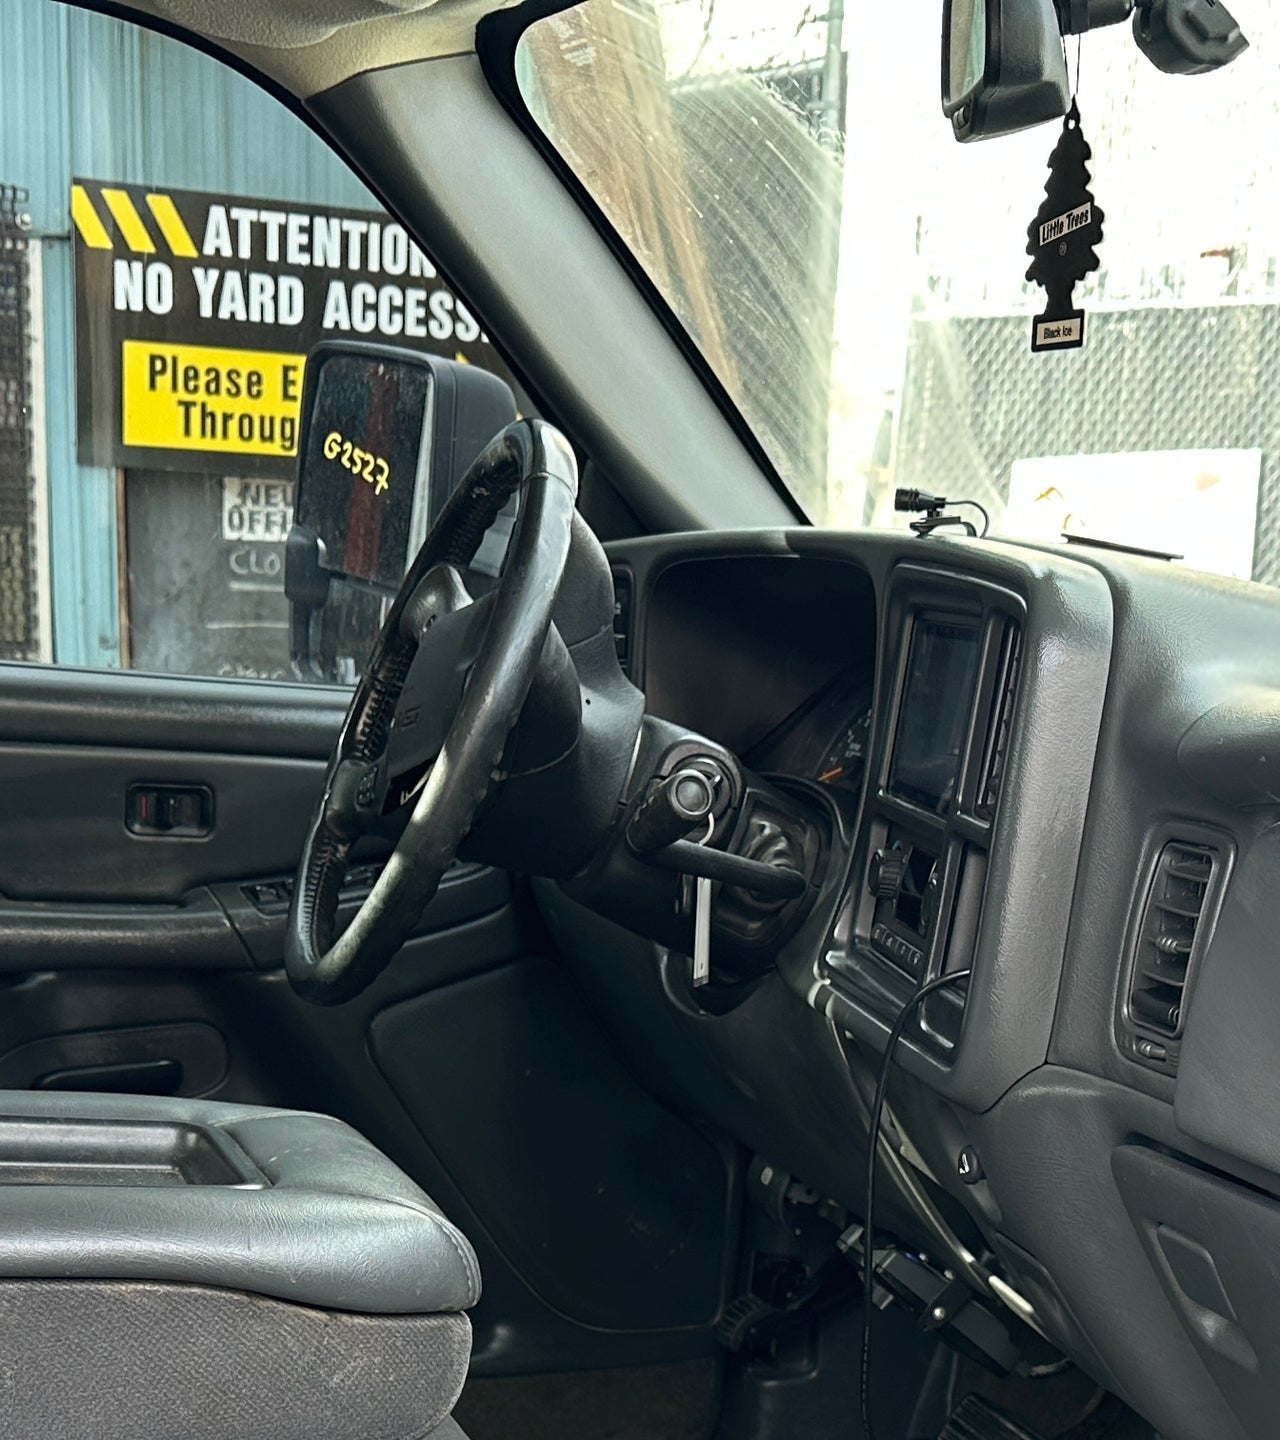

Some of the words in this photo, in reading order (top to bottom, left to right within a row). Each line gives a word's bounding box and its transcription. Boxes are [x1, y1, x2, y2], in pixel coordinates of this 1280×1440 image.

[1041, 218, 1064, 244] Little
[1065, 208, 1090, 232] Trees
[114, 259, 174, 314] NO
[191, 265, 305, 326] YARD
[322, 279, 490, 344] ACCESS
[148, 353, 263, 400] Please
[323, 431, 390, 496] G2527
